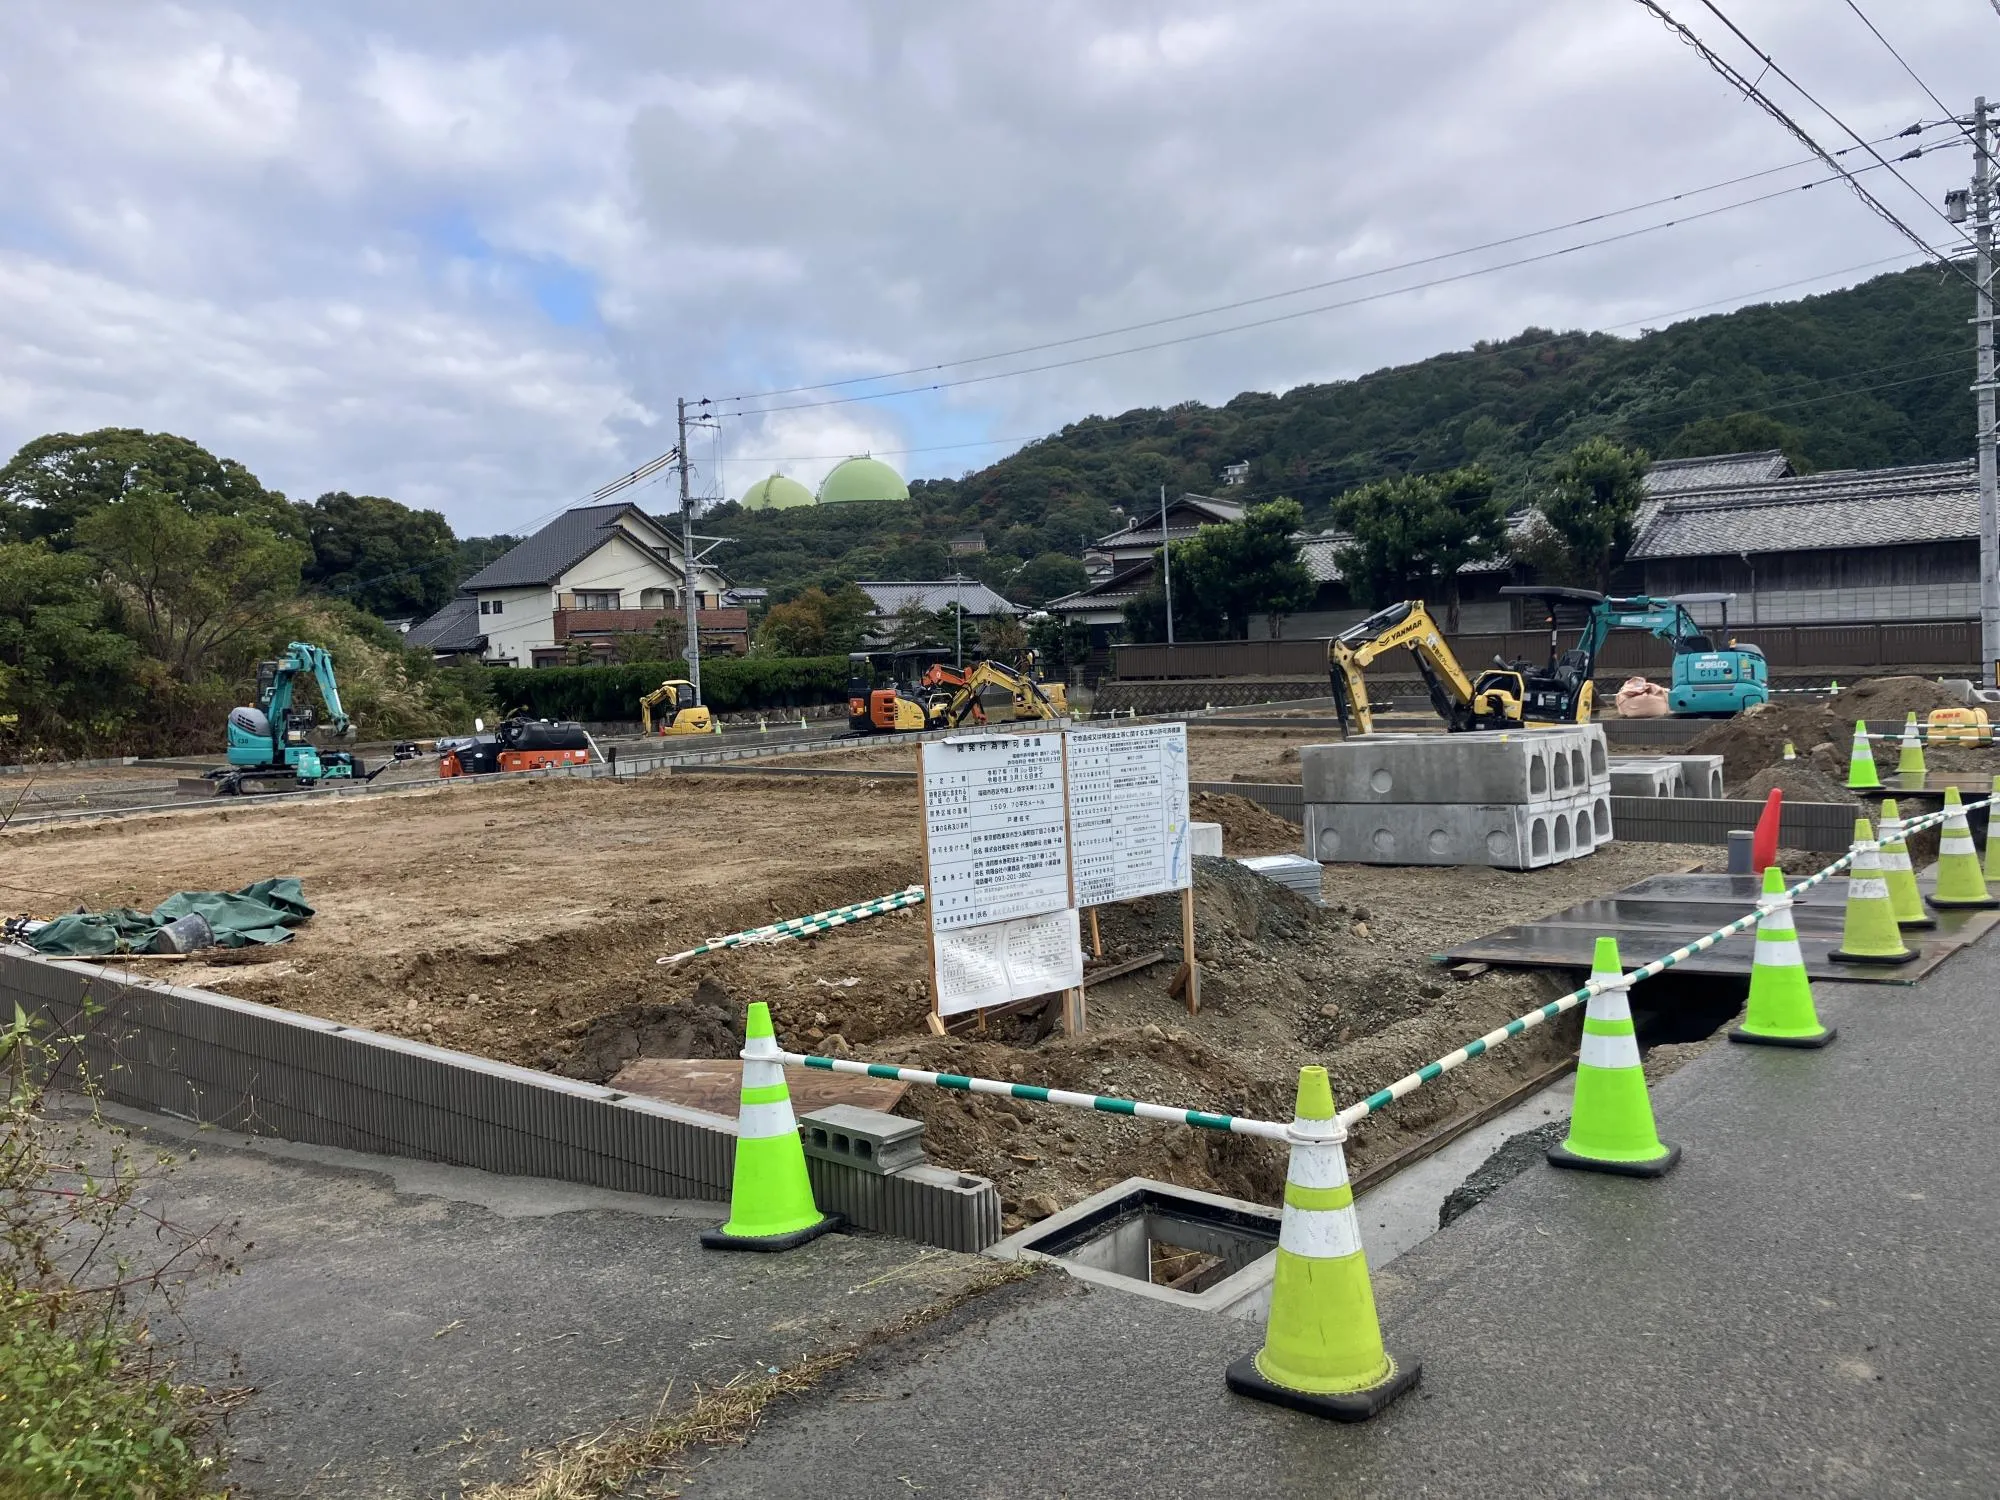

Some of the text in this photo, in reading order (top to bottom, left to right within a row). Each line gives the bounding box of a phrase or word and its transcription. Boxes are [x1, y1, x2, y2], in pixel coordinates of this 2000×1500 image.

[1391, 619, 1422, 641] YANMAR
[1700, 669, 1718, 677] C13
[995, 871, 1031, 882] 093-201-3802
